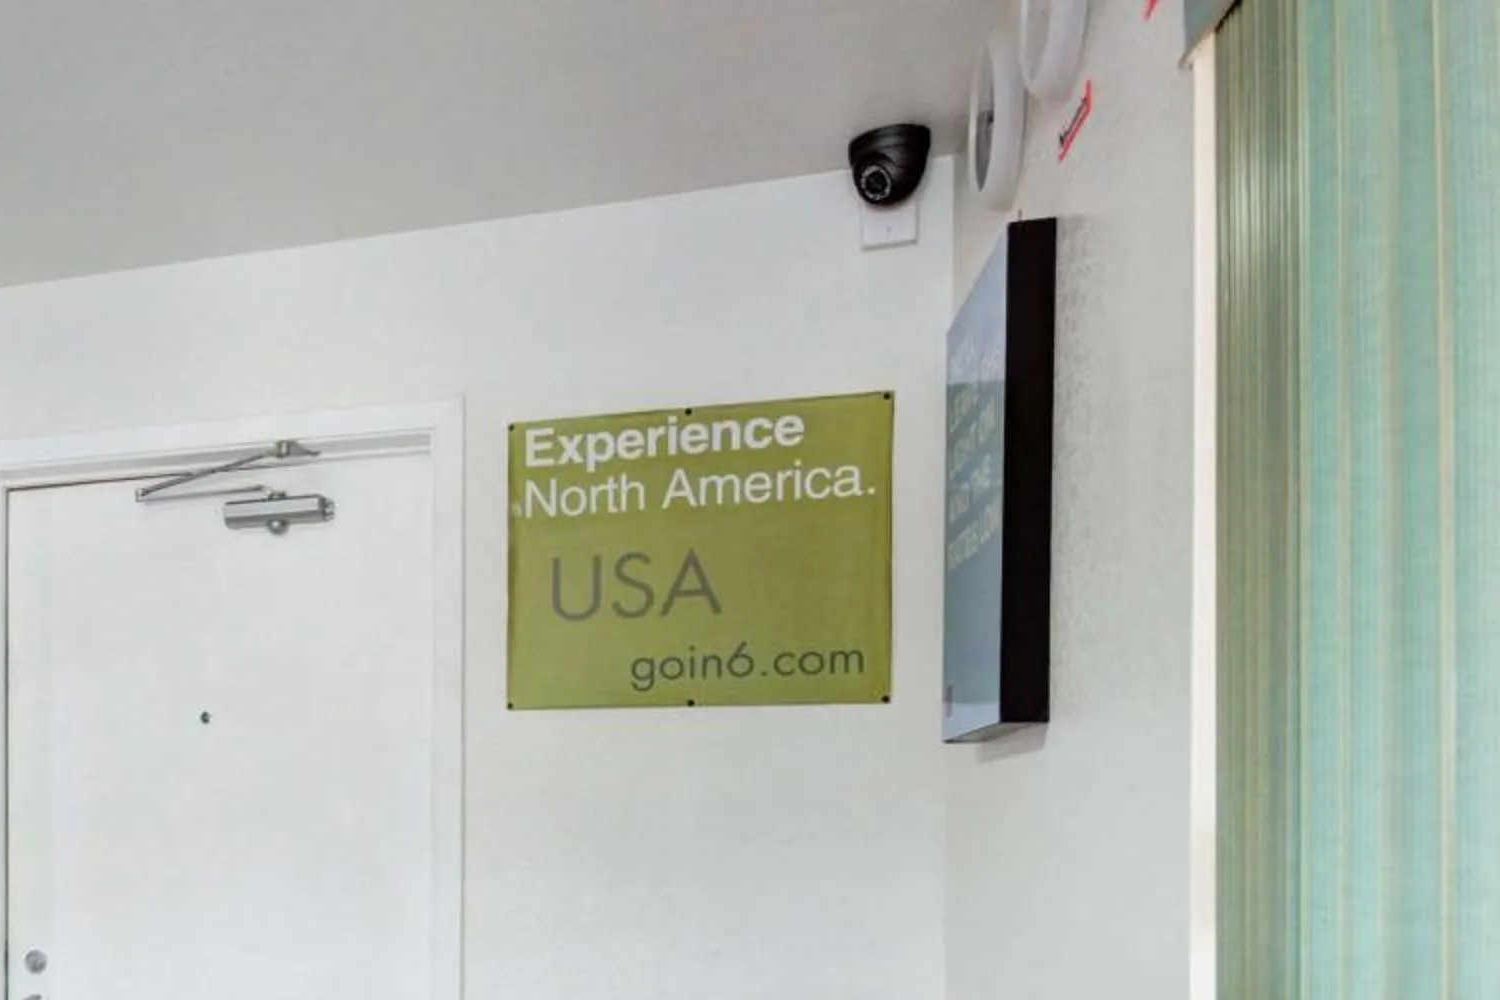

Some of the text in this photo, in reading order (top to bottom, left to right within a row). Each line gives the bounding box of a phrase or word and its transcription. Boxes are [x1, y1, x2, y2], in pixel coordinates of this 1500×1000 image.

[525, 414, 805, 472] Experience
[525, 460, 876, 518] North America.
[551, 548, 723, 622] USA
[630, 641, 865, 692] goin6.com
